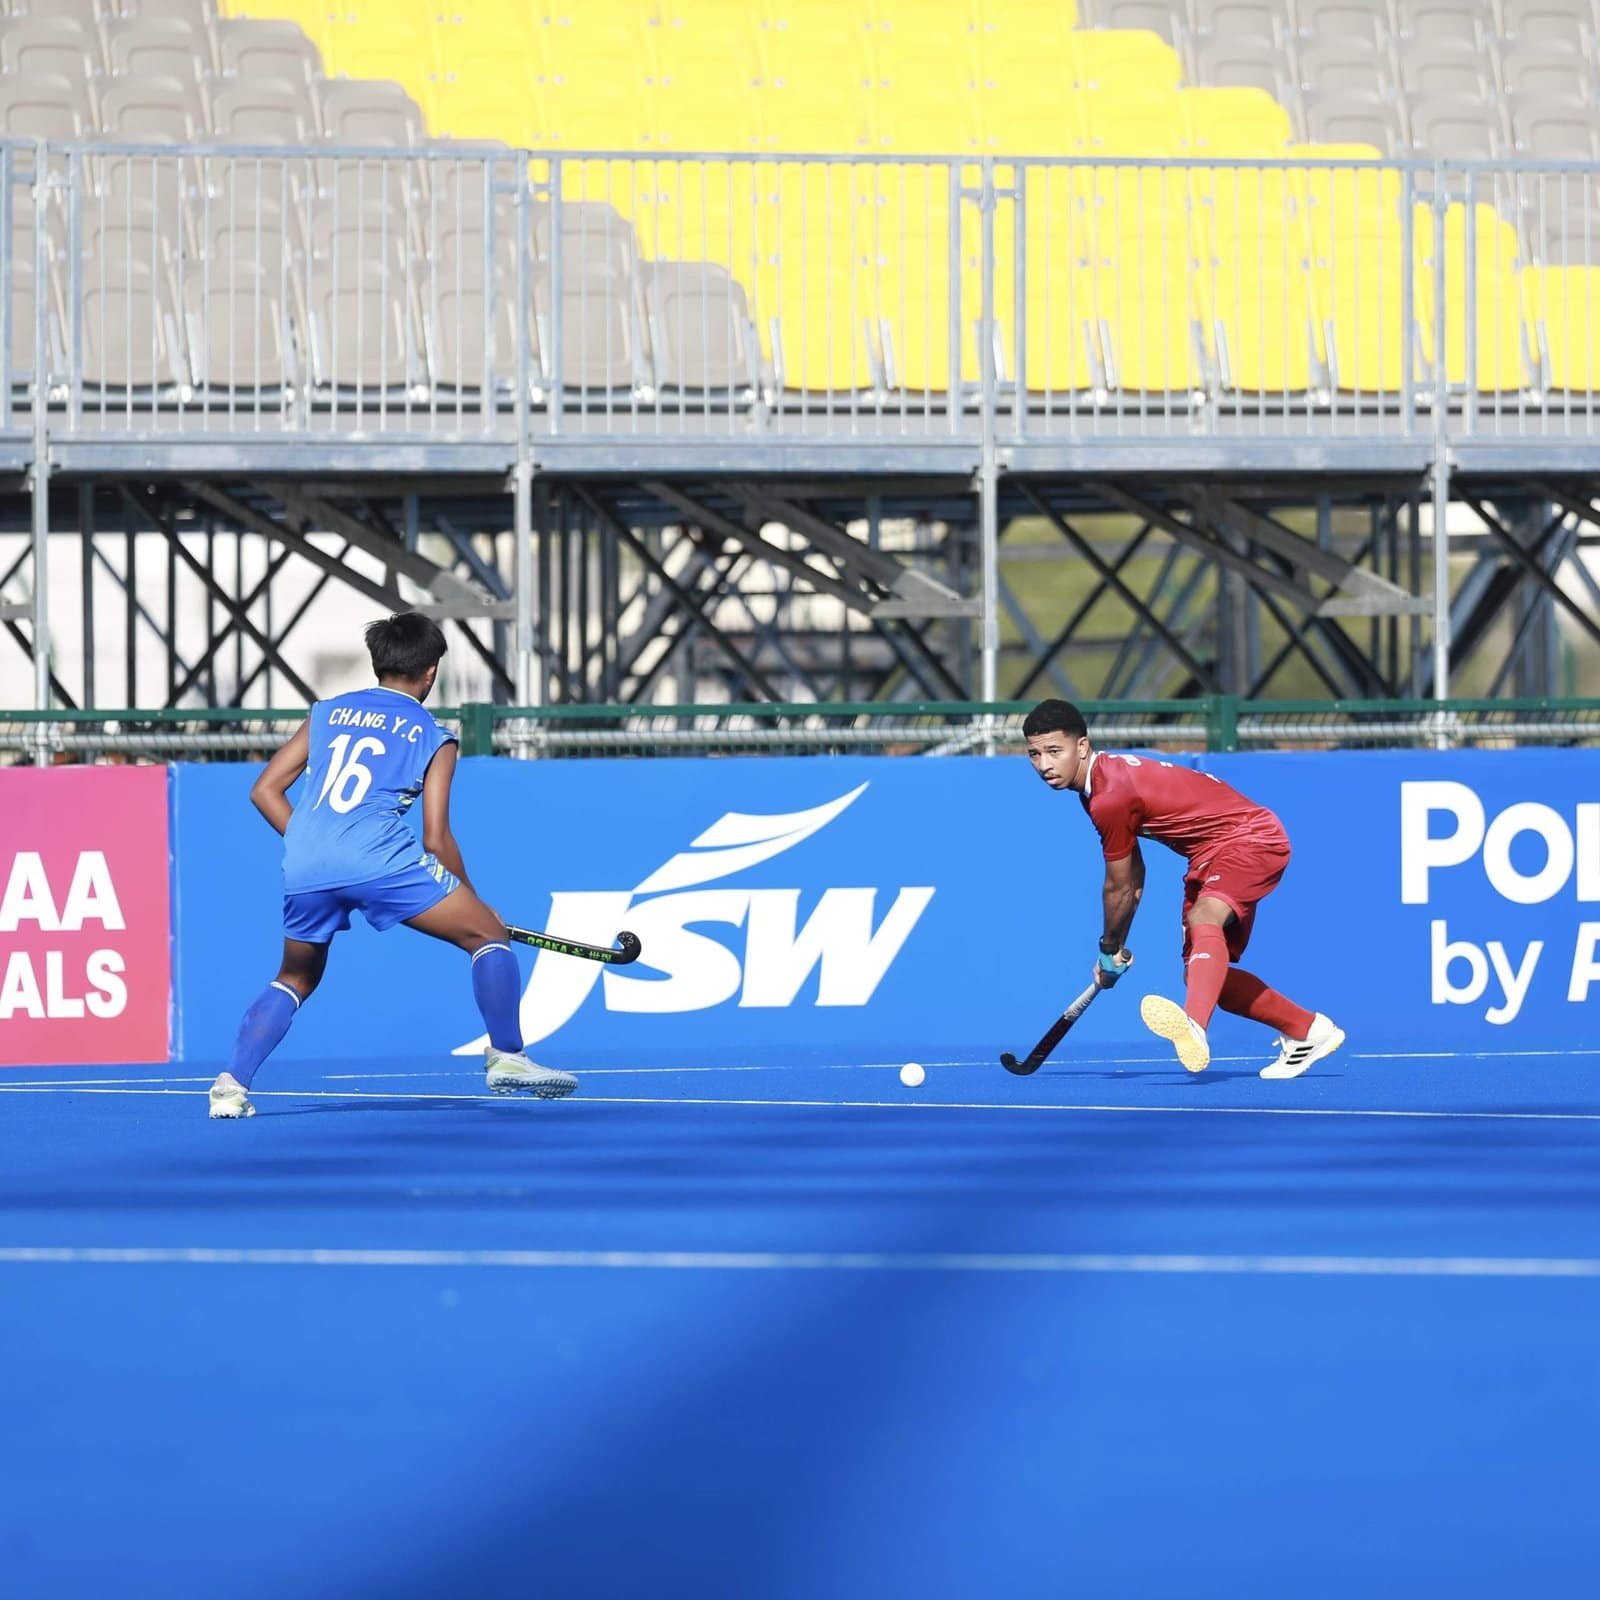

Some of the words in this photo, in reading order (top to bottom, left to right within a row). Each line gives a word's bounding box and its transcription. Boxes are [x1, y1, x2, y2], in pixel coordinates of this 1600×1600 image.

[312, 733, 386, 814] 16
[0, 850, 126, 932] AA
[0, 949, 127, 1019] ALS
[451, 886, 936, 1056] JSW
[527, 936, 568, 953] OSAKA
[1431, 919, 1544, 1025] by
